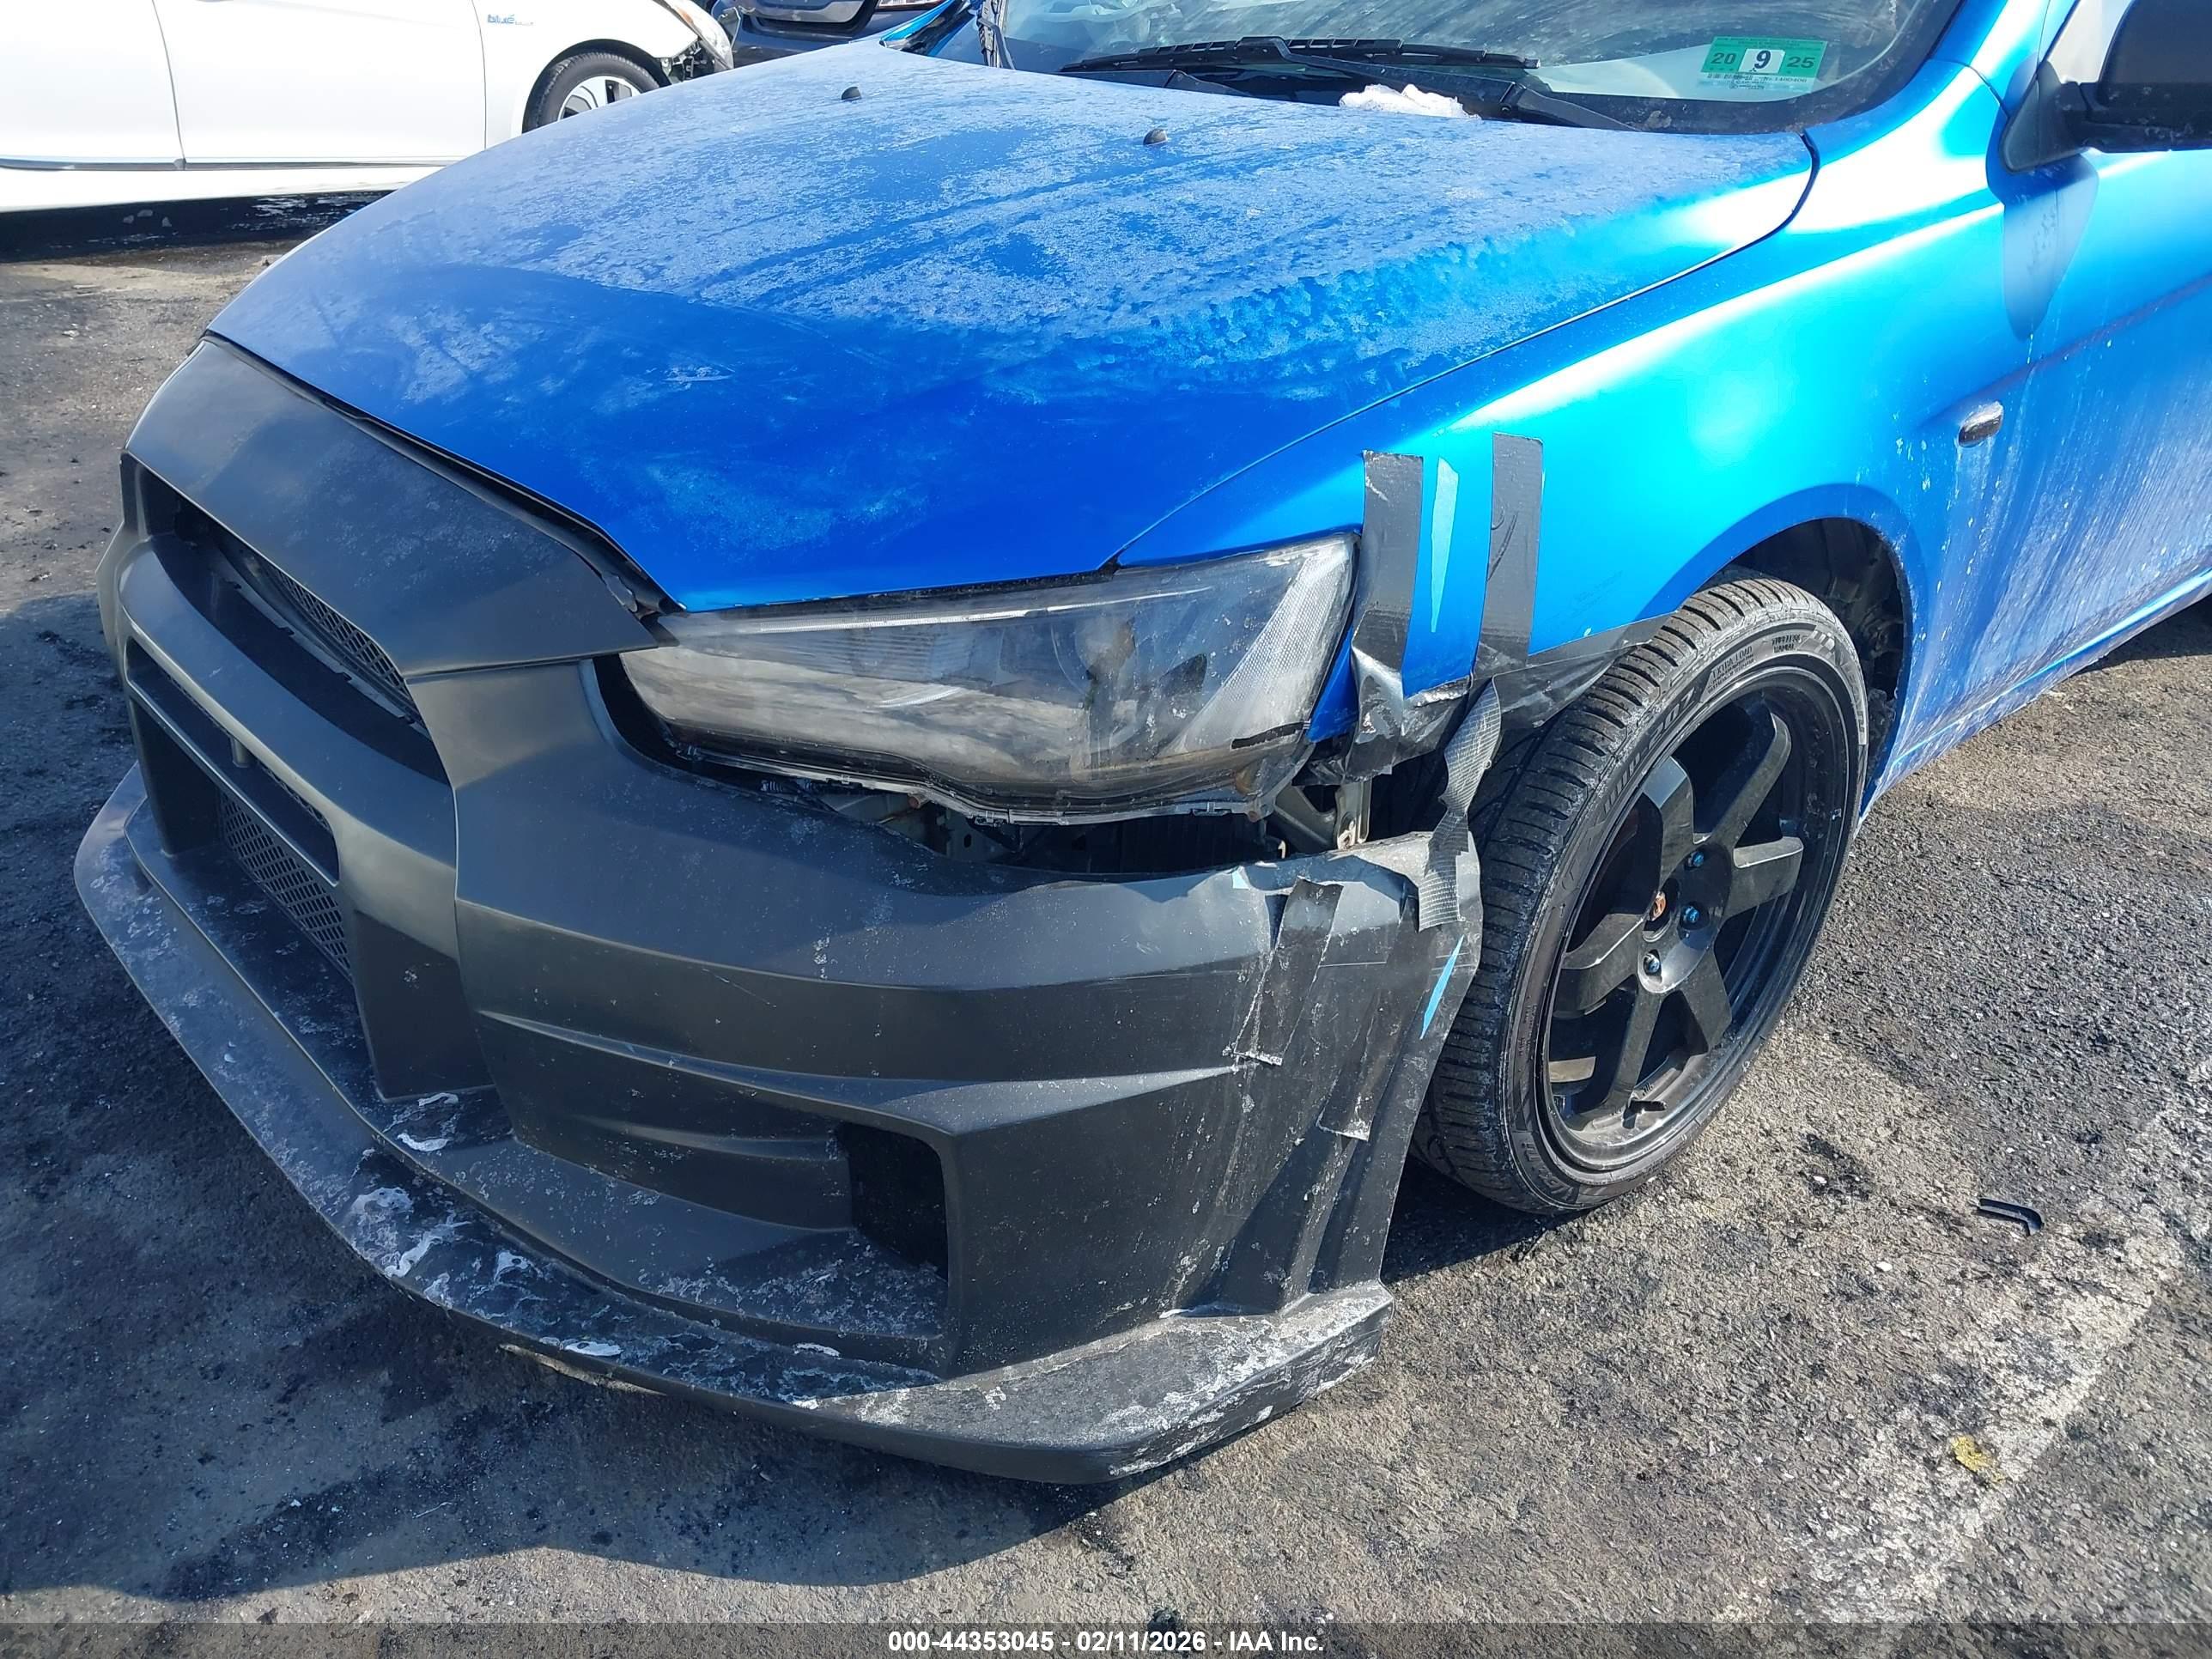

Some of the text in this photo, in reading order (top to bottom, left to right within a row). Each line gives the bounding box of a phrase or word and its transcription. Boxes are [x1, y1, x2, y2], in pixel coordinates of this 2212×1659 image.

[1710, 50, 1815, 70] 20 9 25
